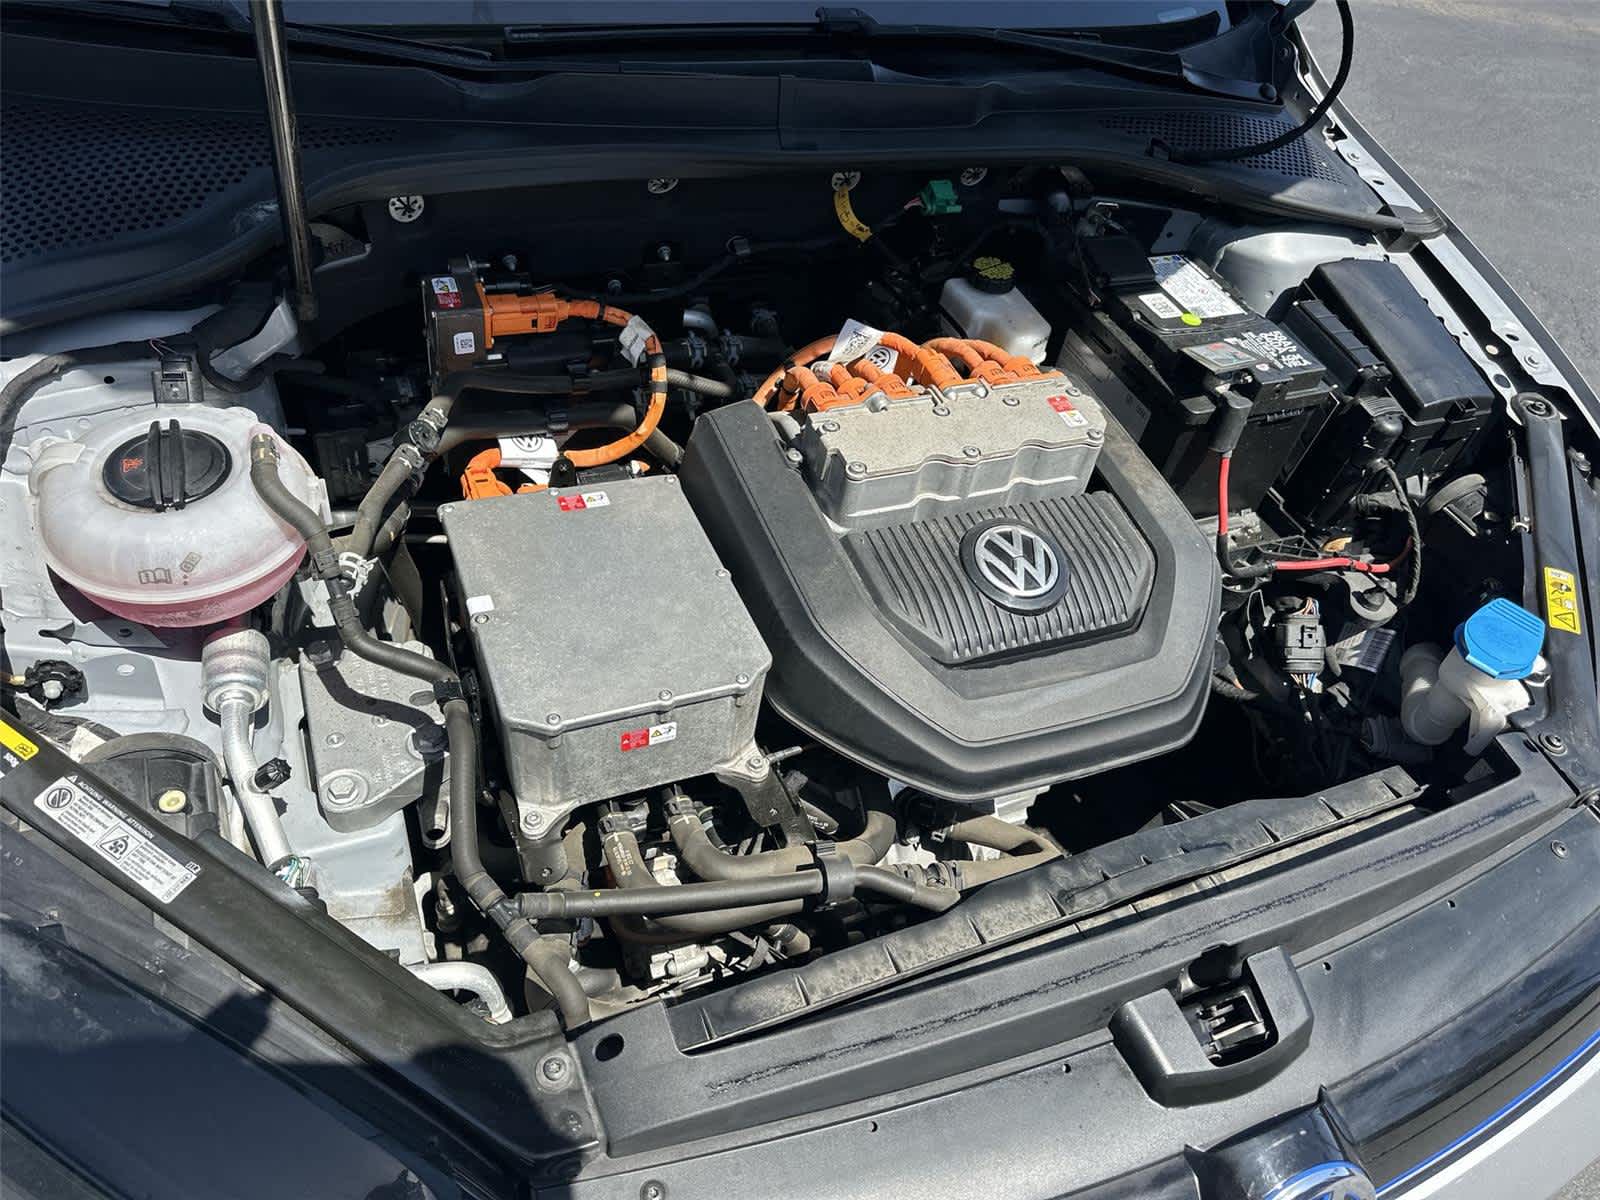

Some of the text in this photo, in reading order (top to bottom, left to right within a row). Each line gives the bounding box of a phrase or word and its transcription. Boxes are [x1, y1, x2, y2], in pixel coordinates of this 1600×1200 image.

[975, 525, 1059, 597] VW
[78, 781, 104, 801] ACHTUNG
[126, 817, 155, 840] ATTENTION
